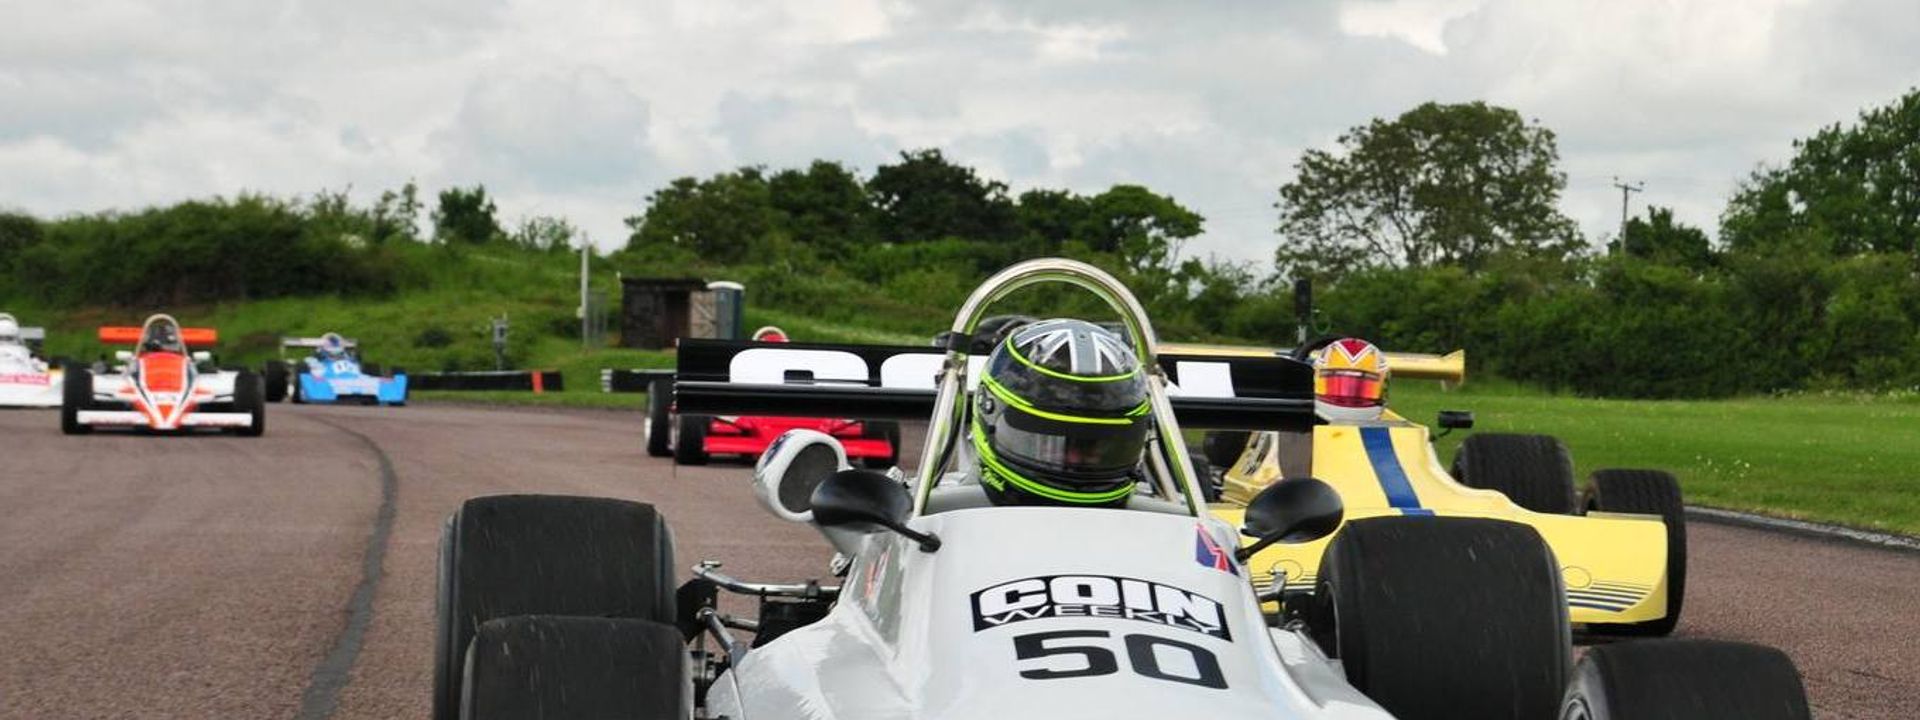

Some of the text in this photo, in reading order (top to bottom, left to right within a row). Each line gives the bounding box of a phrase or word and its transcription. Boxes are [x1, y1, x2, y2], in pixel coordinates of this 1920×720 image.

[979, 576, 1221, 627] COIN
[983, 604, 1221, 634] WEEKLY
[1013, 629, 1229, 689] 50
